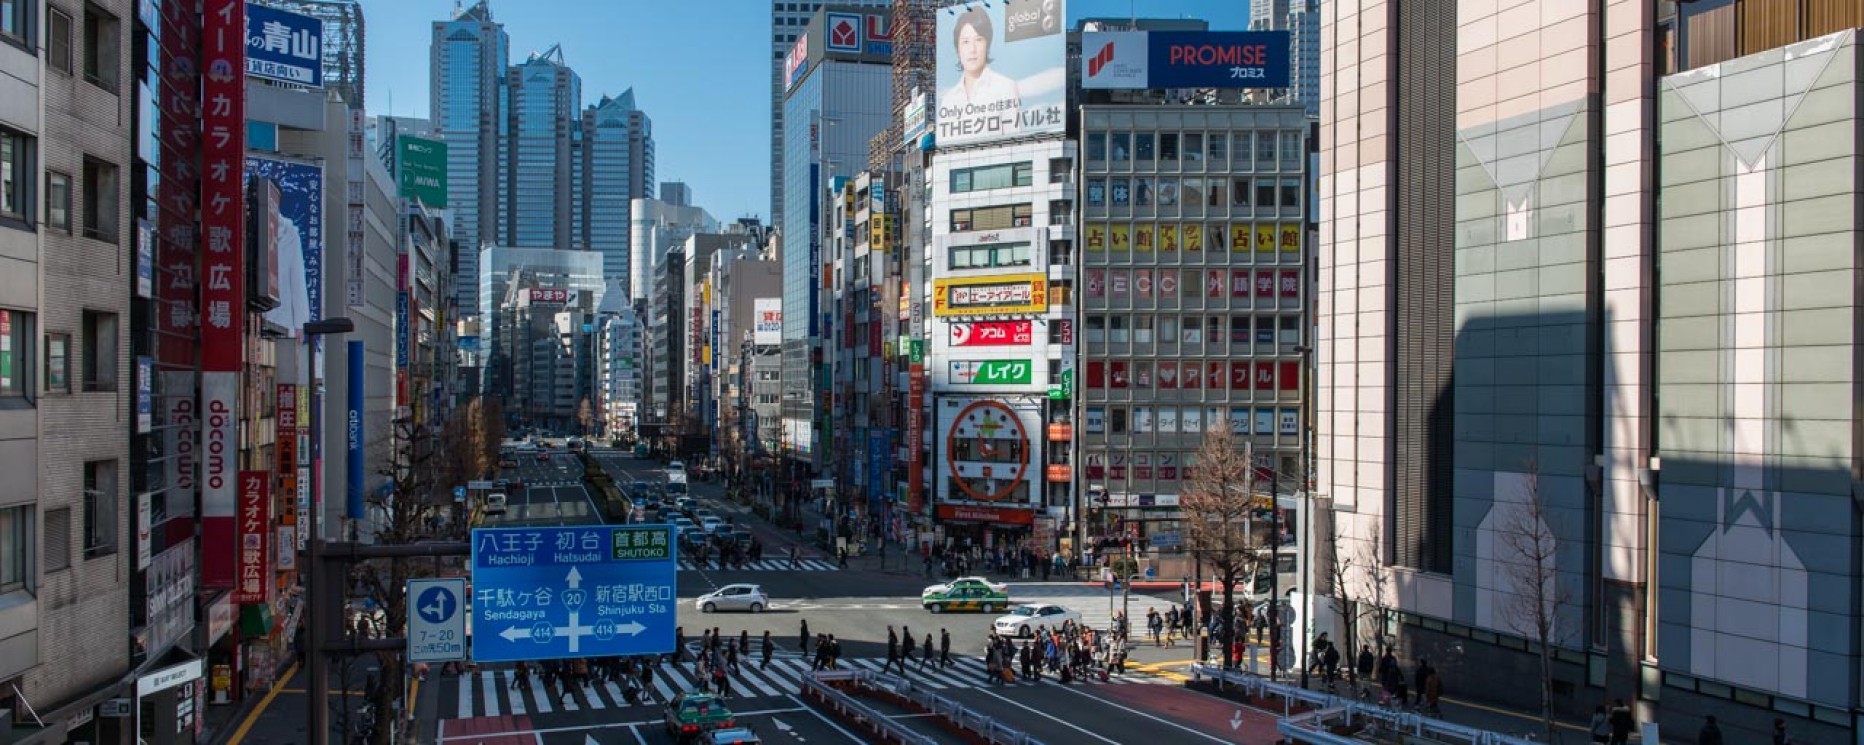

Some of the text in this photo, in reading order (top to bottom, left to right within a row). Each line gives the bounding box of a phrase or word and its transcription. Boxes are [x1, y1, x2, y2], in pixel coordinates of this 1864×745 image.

[1008, 9, 1041, 32] global
[246, 21, 318, 60] の青山
[1169, 45, 1267, 66] PROMISE
[1229, 66, 1265, 79] プロミス
[939, 98, 1022, 119] Only One の住まい
[939, 106, 1061, 137] THEグローバル社
[415, 176, 441, 188] MIWA
[208, 93, 232, 329] カラオケ歌広場
[1087, 229, 1153, 248] 占い館
[1232, 229, 1298, 248] 占い館
[1113, 277, 1176, 292] ECC
[1208, 276, 1297, 292] 外語学院
[531, 289, 567, 301] やまや
[971, 289, 1030, 302] エーアイアール
[980, 327, 1006, 338] アコム
[988, 363, 1025, 379] レイク
[1185, 368, 1272, 383] アイフル
[209, 400, 230, 490] docomo
[245, 476, 260, 532] カラオケ
[478, 531, 601, 553] 八王子 初台
[614, 531, 667, 547] 首都高
[488, 551, 602, 566] Hachioji Hatsudai
[617, 548, 664, 558] SHUTOKO
[243, 548, 260, 593] 歌広場
[567, 593, 581, 605] 20
[596, 583, 671, 603] 新宿駅西口
[484, 609, 546, 620] Sendagaya
[597, 603, 645, 616] Shinjuku
[534, 627, 550, 639] 414
[596, 624, 613, 636] 414
